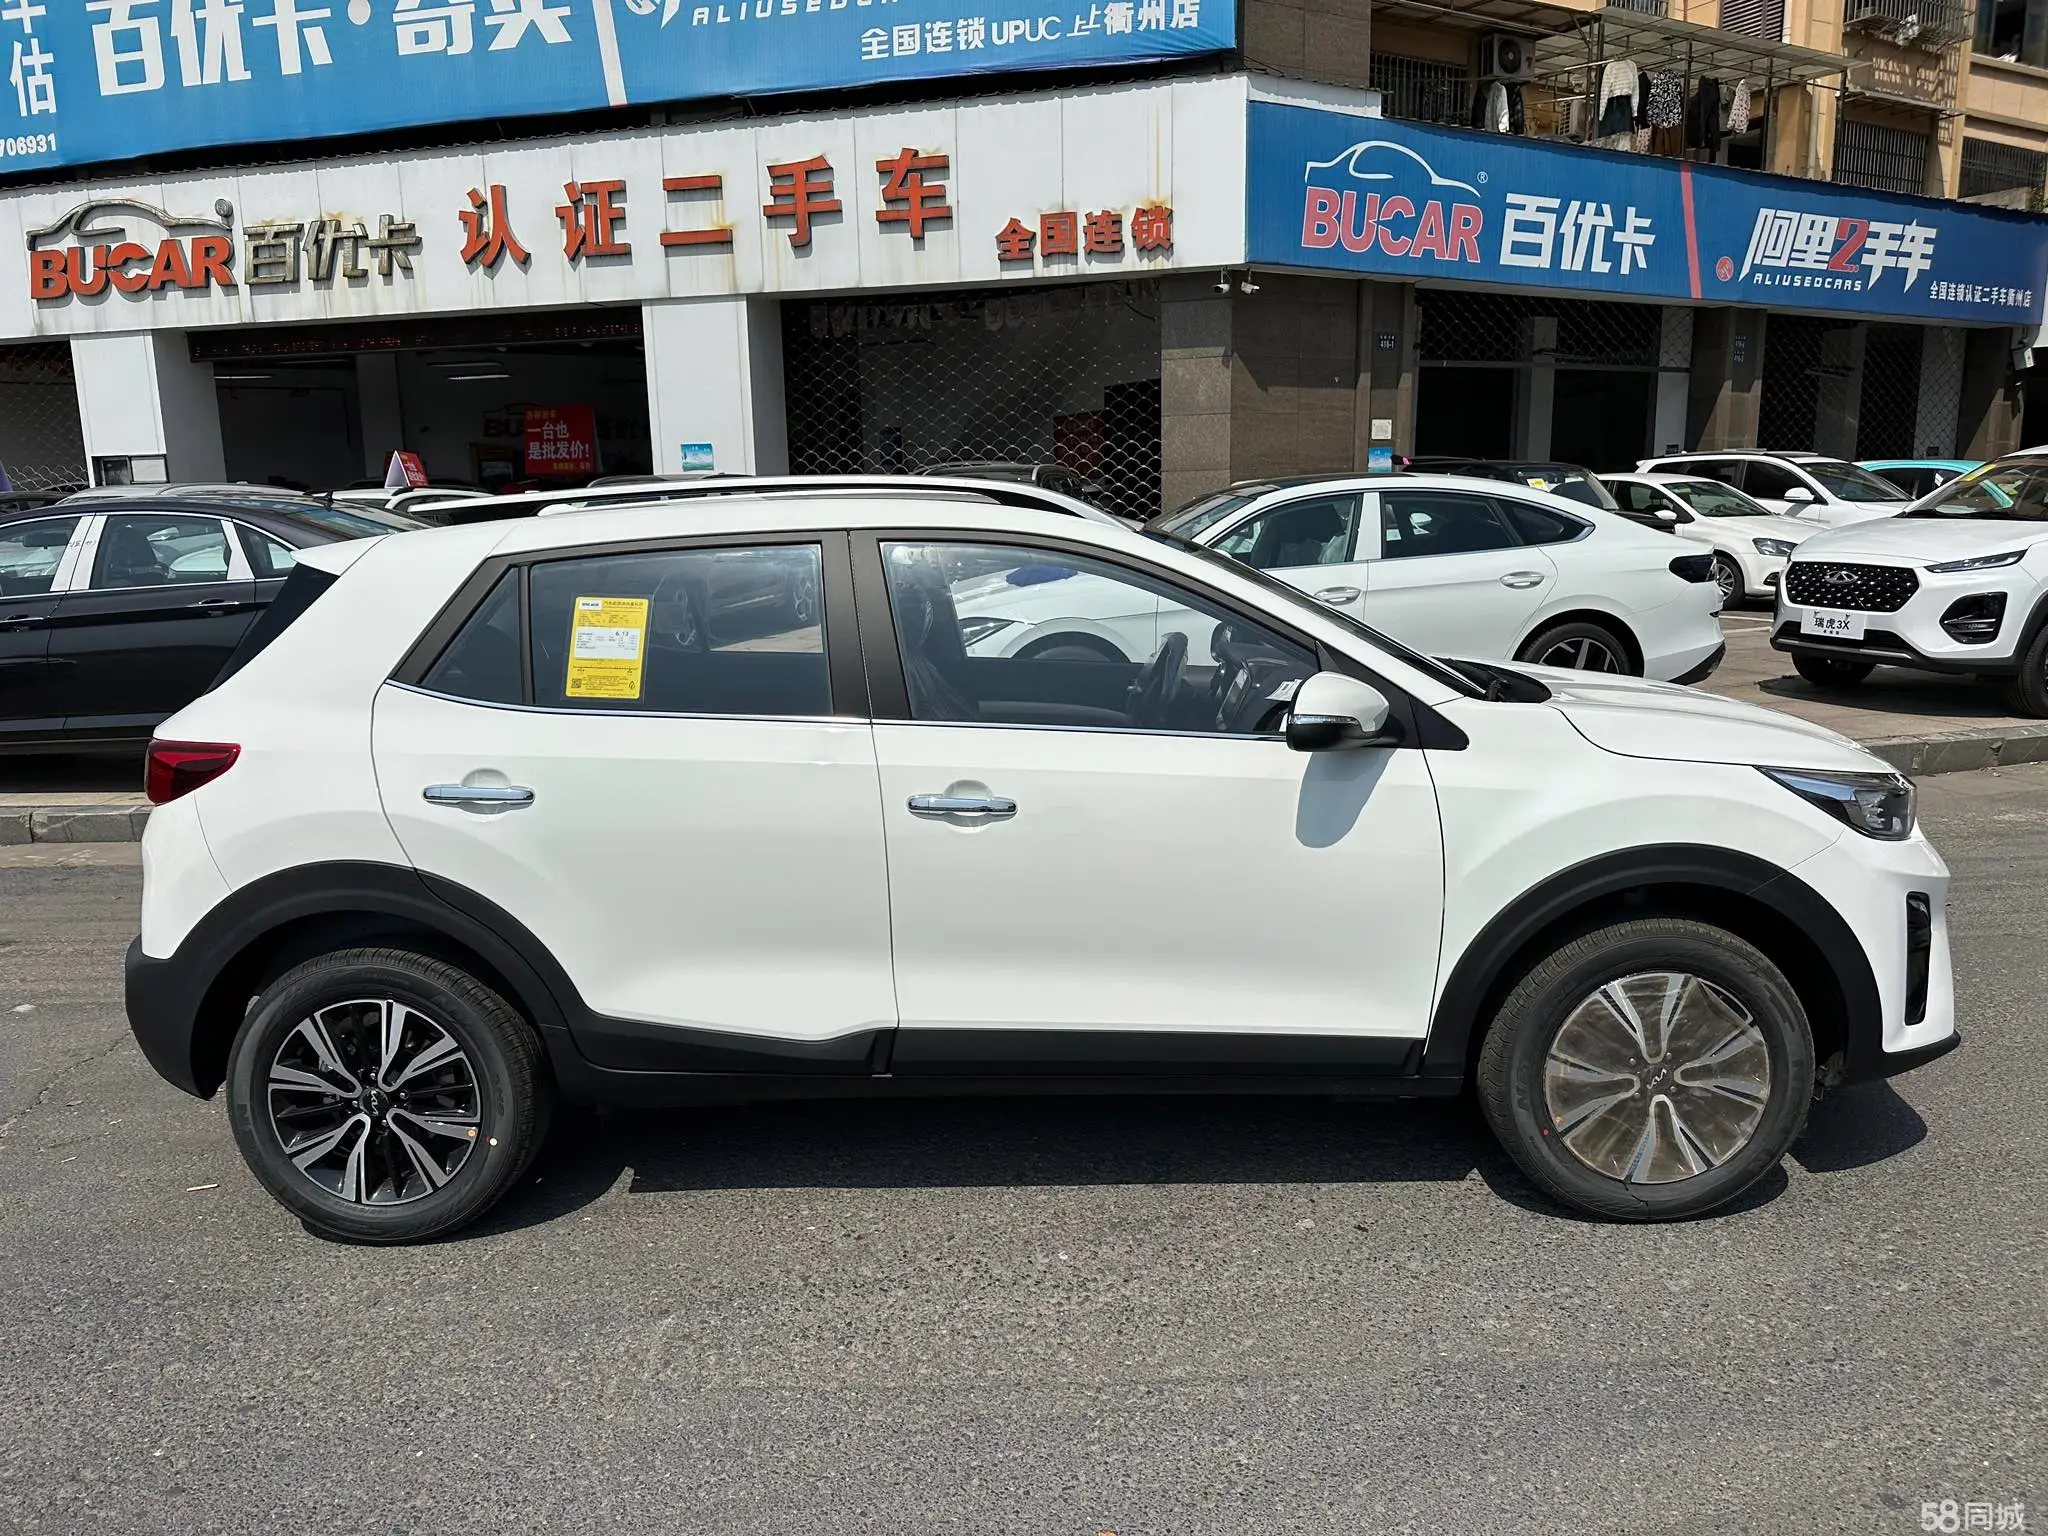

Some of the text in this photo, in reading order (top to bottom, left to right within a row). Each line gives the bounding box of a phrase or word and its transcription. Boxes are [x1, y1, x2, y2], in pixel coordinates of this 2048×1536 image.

[457, 147, 954, 268] 认证二手车
[996, 206, 1174, 262] 全国连锁
[1301, 185, 1656, 275] BUCAR 百优卡
[29, 214, 422, 301] BUCAR 百优卡
[1753, 273, 1862, 291] ALIUSEDCARS
[1814, 617, 1850, 630] 瑞虎3X
